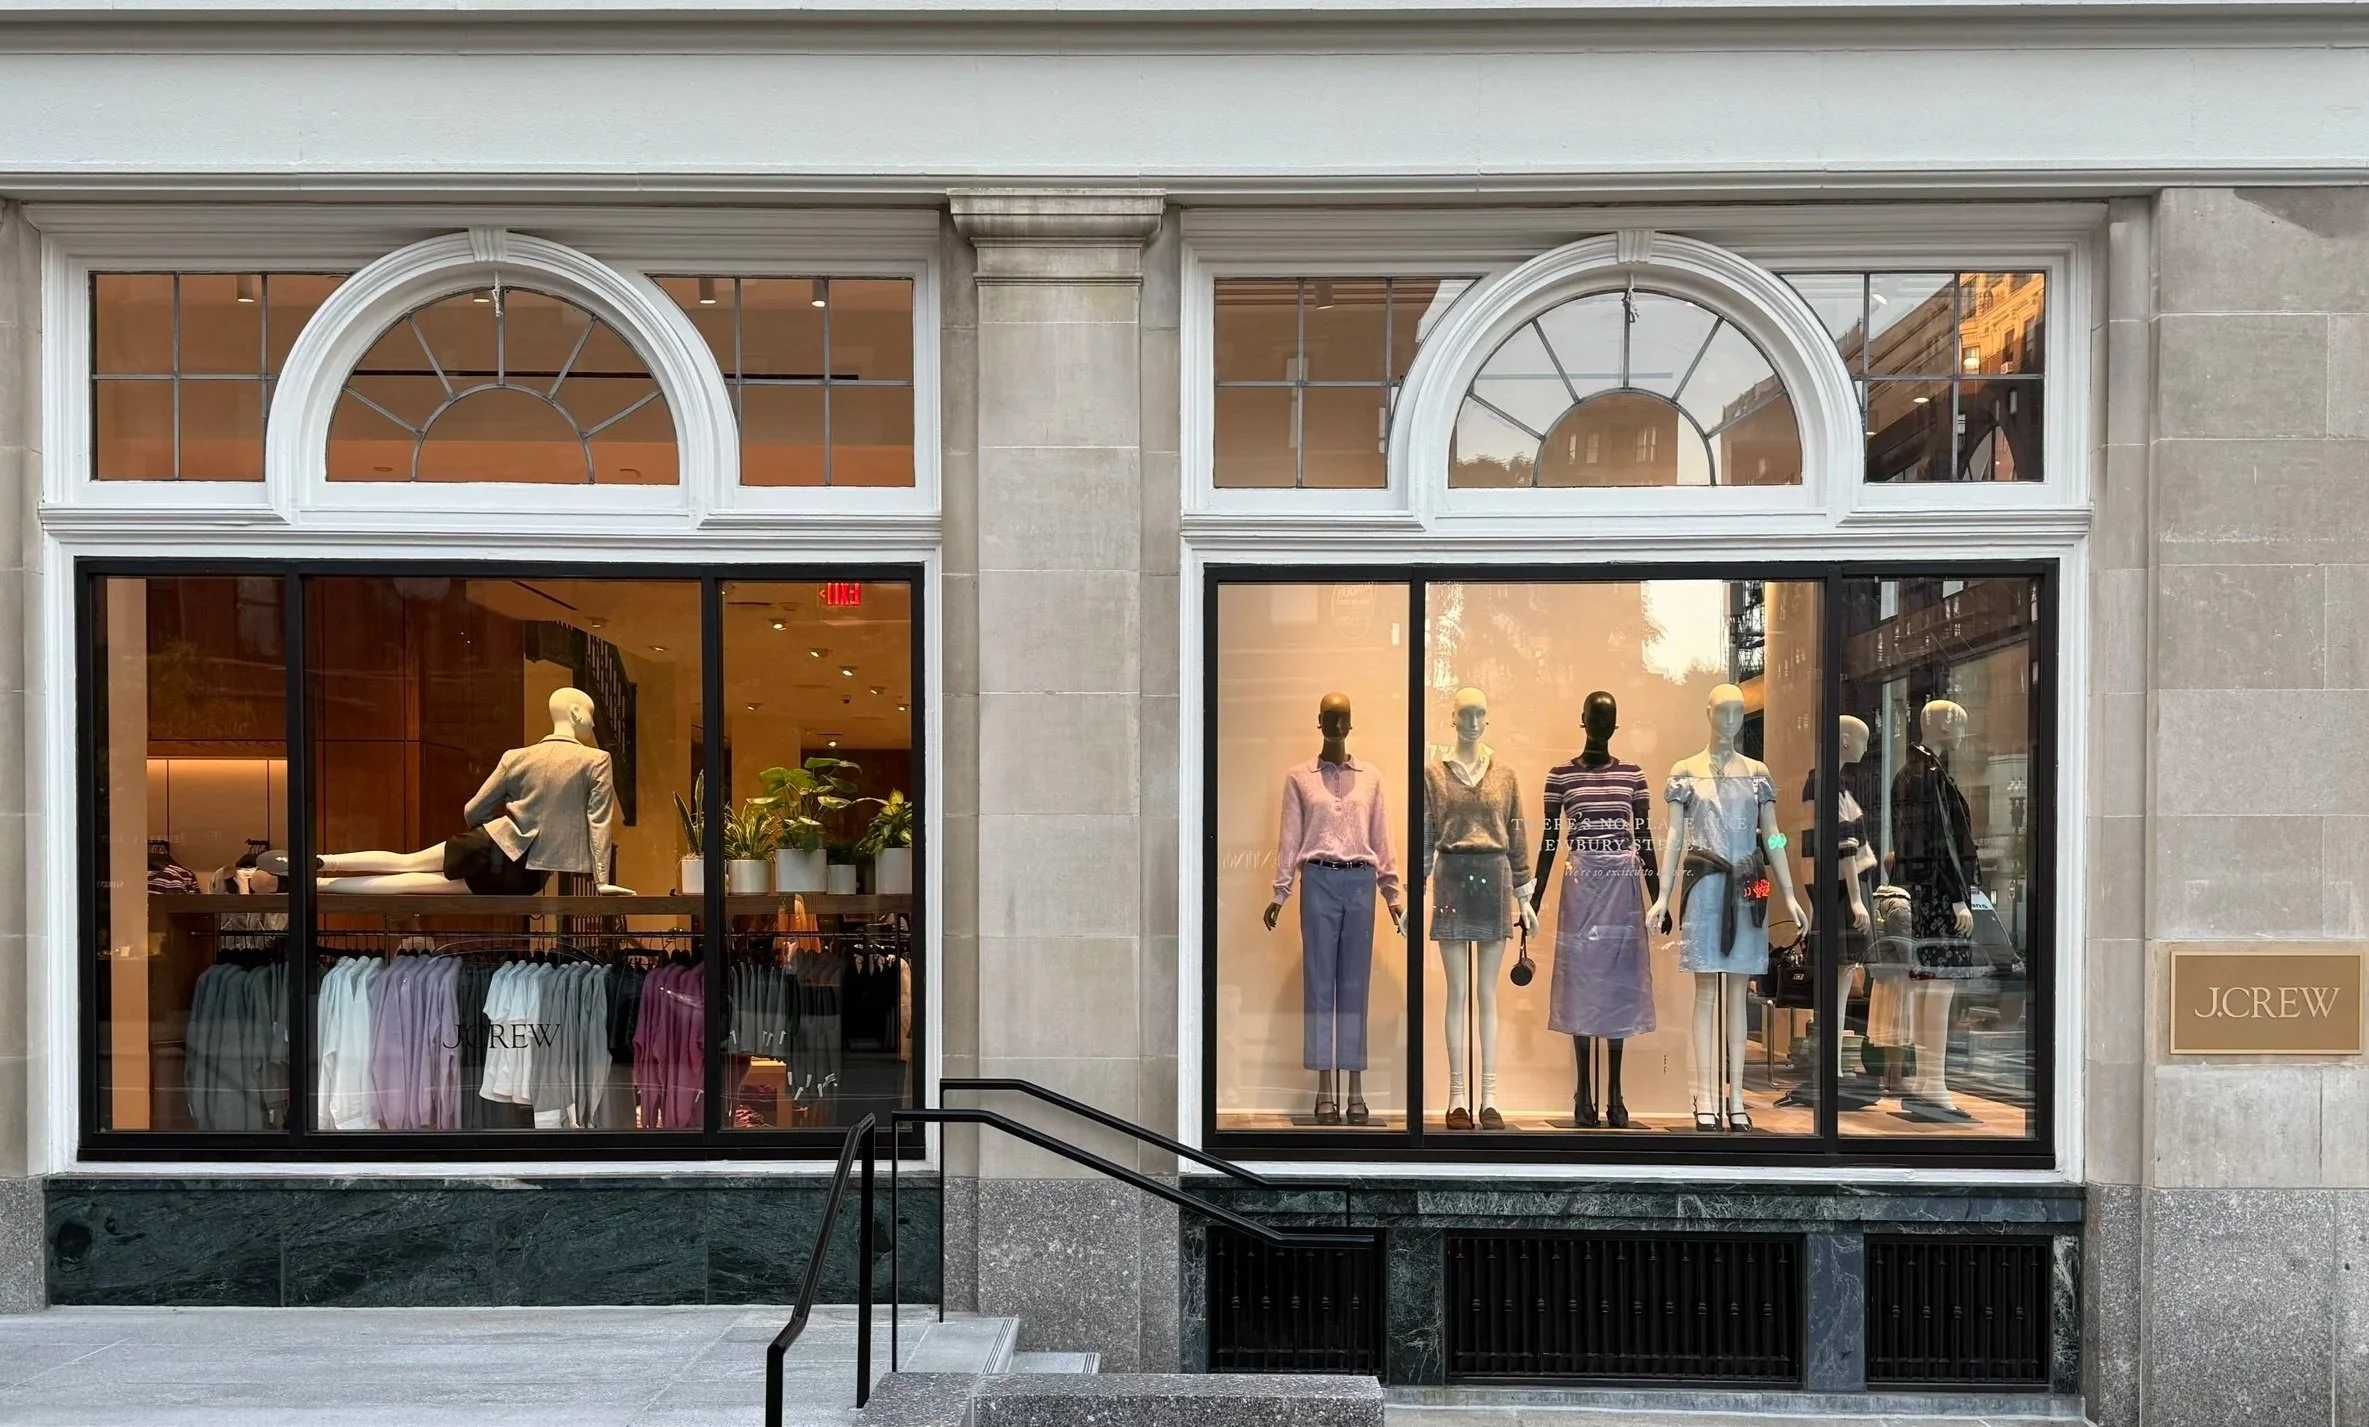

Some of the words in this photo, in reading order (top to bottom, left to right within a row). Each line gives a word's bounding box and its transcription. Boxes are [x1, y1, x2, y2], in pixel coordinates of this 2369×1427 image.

[1600, 818, 1628, 830] NO
[1592, 868, 1603, 876] so
[2194, 986, 2342, 1019] J.CREW
